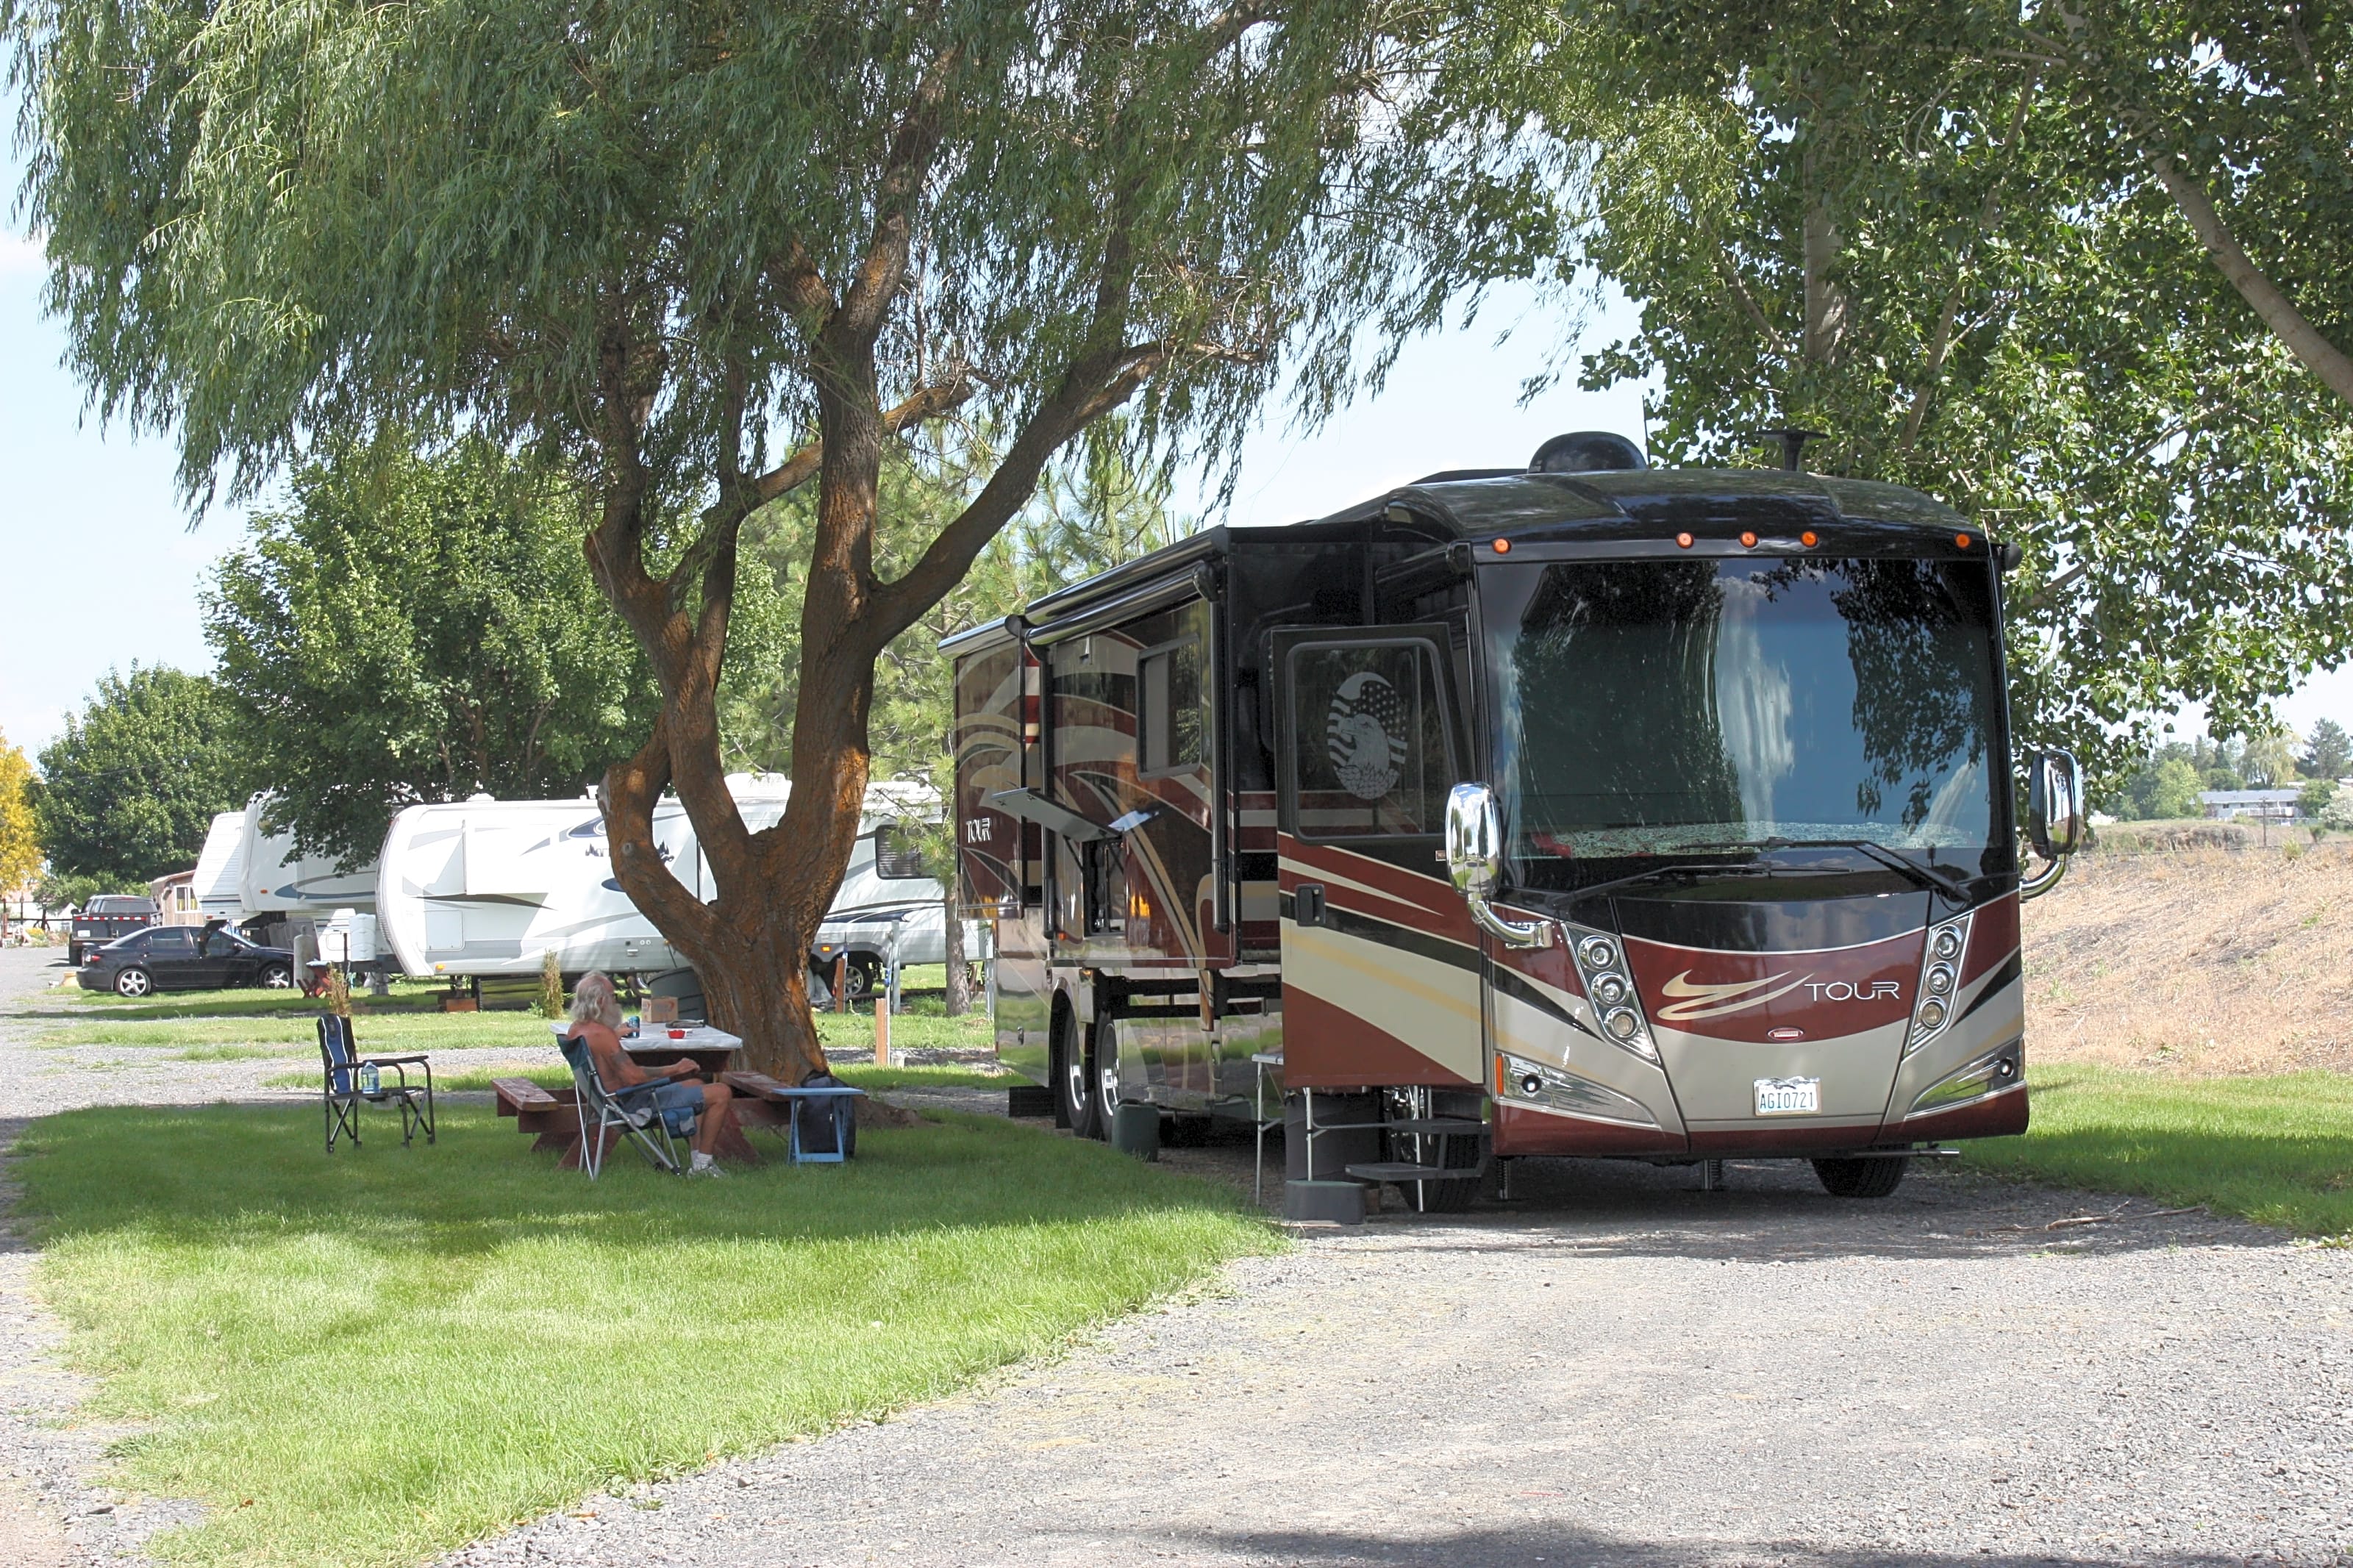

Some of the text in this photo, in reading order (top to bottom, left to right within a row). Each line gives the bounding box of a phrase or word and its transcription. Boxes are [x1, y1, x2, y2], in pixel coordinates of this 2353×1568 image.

[965, 817, 992, 843] TOUR
[1804, 981, 1900, 1001] TOUR
[1760, 1092, 1813, 1109] AGI0721
